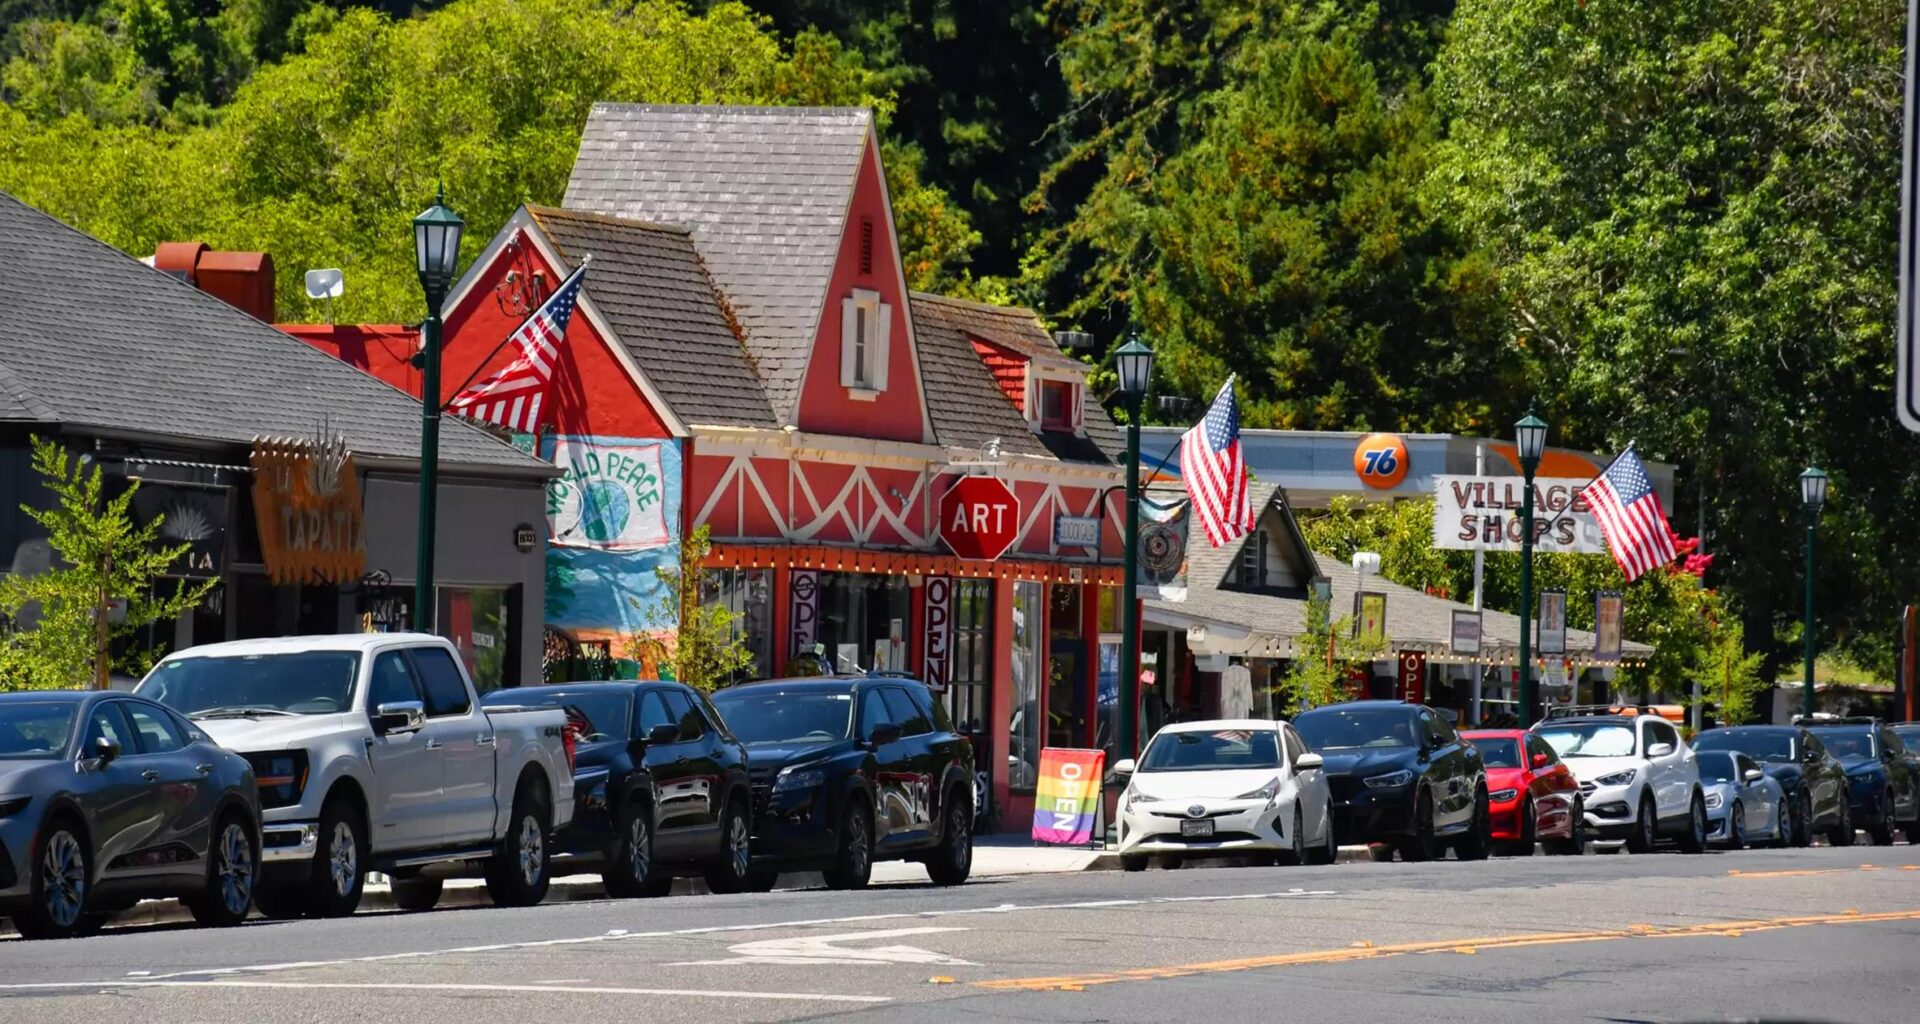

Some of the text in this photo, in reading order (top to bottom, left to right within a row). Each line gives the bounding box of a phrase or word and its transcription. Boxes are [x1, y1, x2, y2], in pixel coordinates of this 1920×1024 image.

[1363, 448, 1398, 476] 76
[547, 452, 660, 515] WORLD PEACE
[1450, 480, 1591, 513] VILLAGE
[281, 506, 366, 552] TAPATIA
[951, 503, 1008, 534] ART
[1458, 514, 1576, 545] SHOPS
[926, 579, 948, 686] OPEN
[1052, 762, 1082, 831] OPEN
